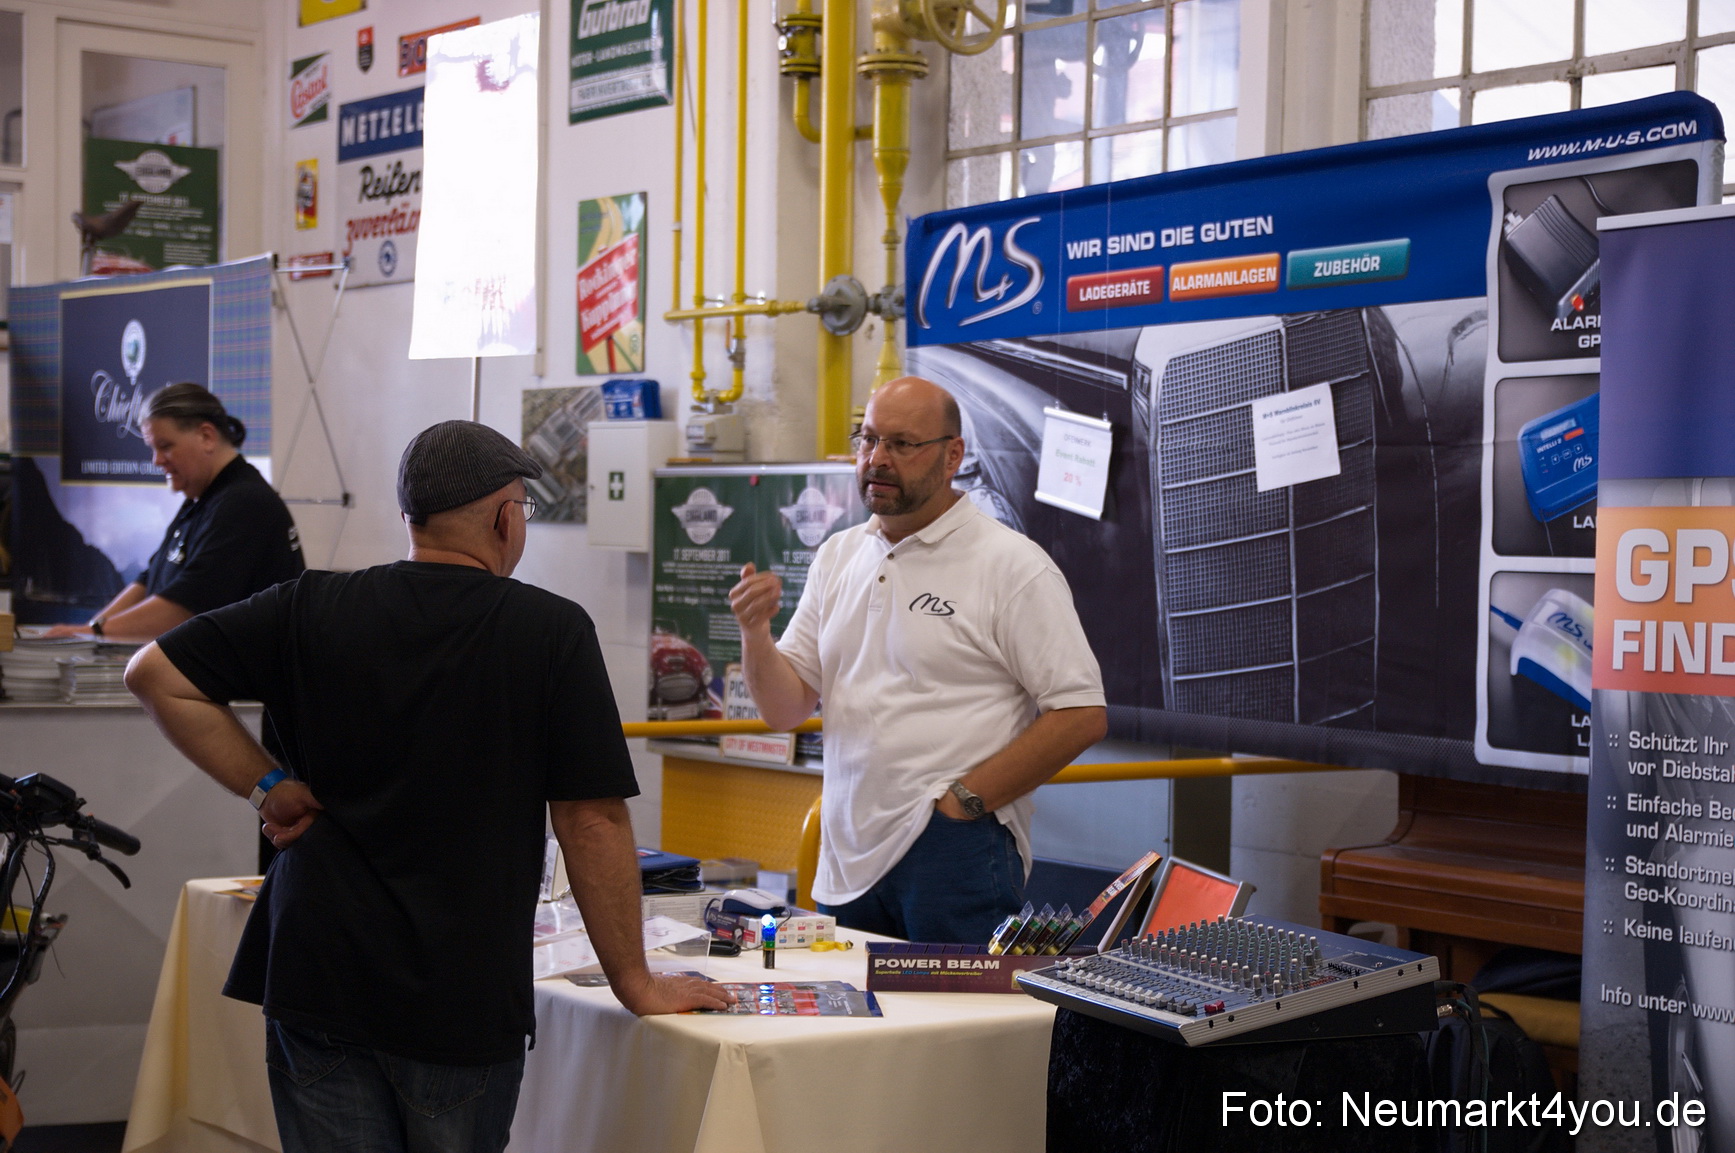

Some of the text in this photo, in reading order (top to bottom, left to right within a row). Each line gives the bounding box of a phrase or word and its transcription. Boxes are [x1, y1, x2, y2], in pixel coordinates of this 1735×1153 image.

[358, 160, 421, 205] Reifen
[1067, 215, 1273, 260] WIR SIND DIE GUTEN
[1079, 253, 1381, 302] LADEGERÄTE ALARMANLAGEN ZUBEHÖR
[1550, 315, 1601, 331] ALAR
[686, 510, 718, 523] ENGLAND
[1573, 515, 1597, 529] LA
[681, 549, 716, 562] SEPTEMBER
[716, 549, 731, 562] 2011
[725, 737, 738, 749] CITY
[747, 740, 787, 756] WESTMINSTER
[1628, 731, 1729, 755] Schützt Ihr
[1628, 760, 1657, 777] vor
[1627, 793, 1703, 818] Einfache
[1626, 821, 1659, 840] und
[1624, 918, 1673, 942] Keine
[874, 958, 999, 970] POWER BEAM
[1601, 983, 1632, 1006] Info
[1638, 993, 1687, 1015] unter
